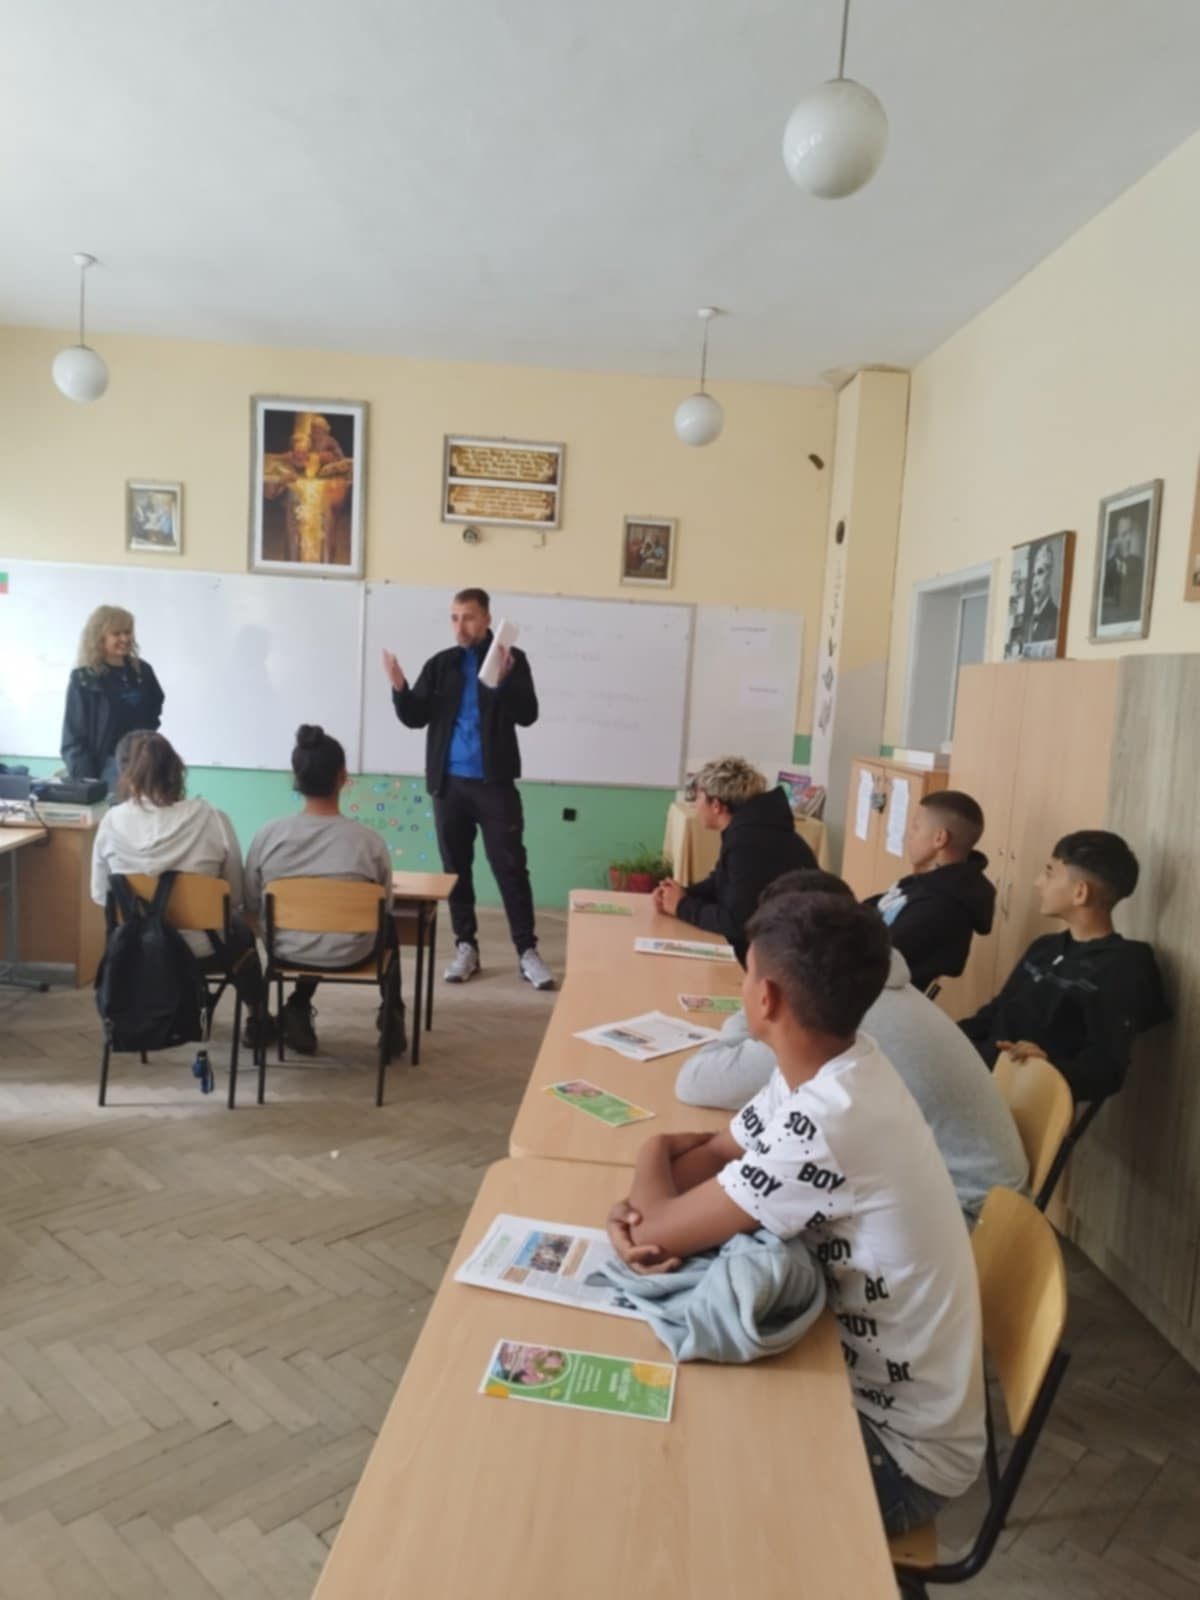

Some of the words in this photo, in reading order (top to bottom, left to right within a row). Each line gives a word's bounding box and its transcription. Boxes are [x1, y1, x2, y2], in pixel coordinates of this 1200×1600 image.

[741, 1104, 766, 1138] BOY
[740, 1164, 783, 1197] BOY
[797, 1162, 846, 1191] BOY
